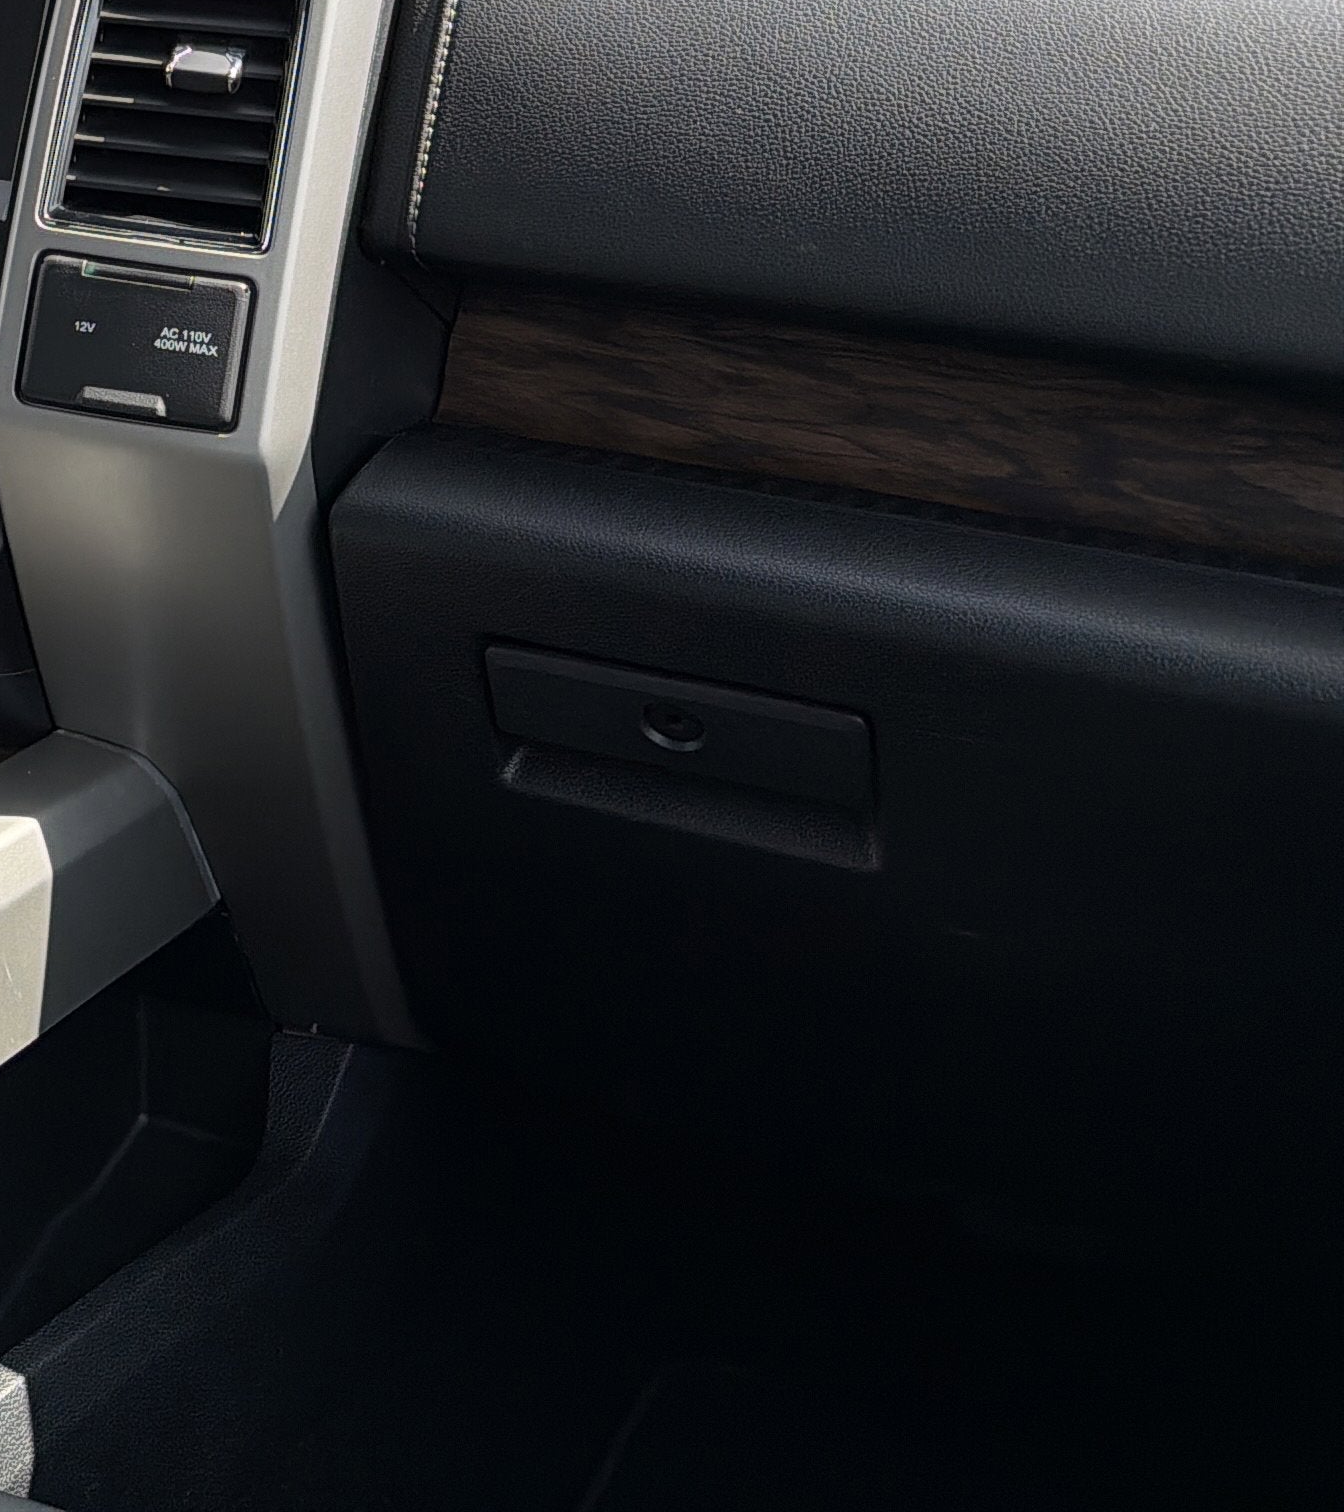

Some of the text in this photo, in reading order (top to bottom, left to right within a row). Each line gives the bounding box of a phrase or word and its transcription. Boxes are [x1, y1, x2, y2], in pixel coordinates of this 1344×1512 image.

[73, 320, 96, 333] 12V
[160, 327, 212, 344] AC 110V
[153, 339, 219, 357] 400W MAX
